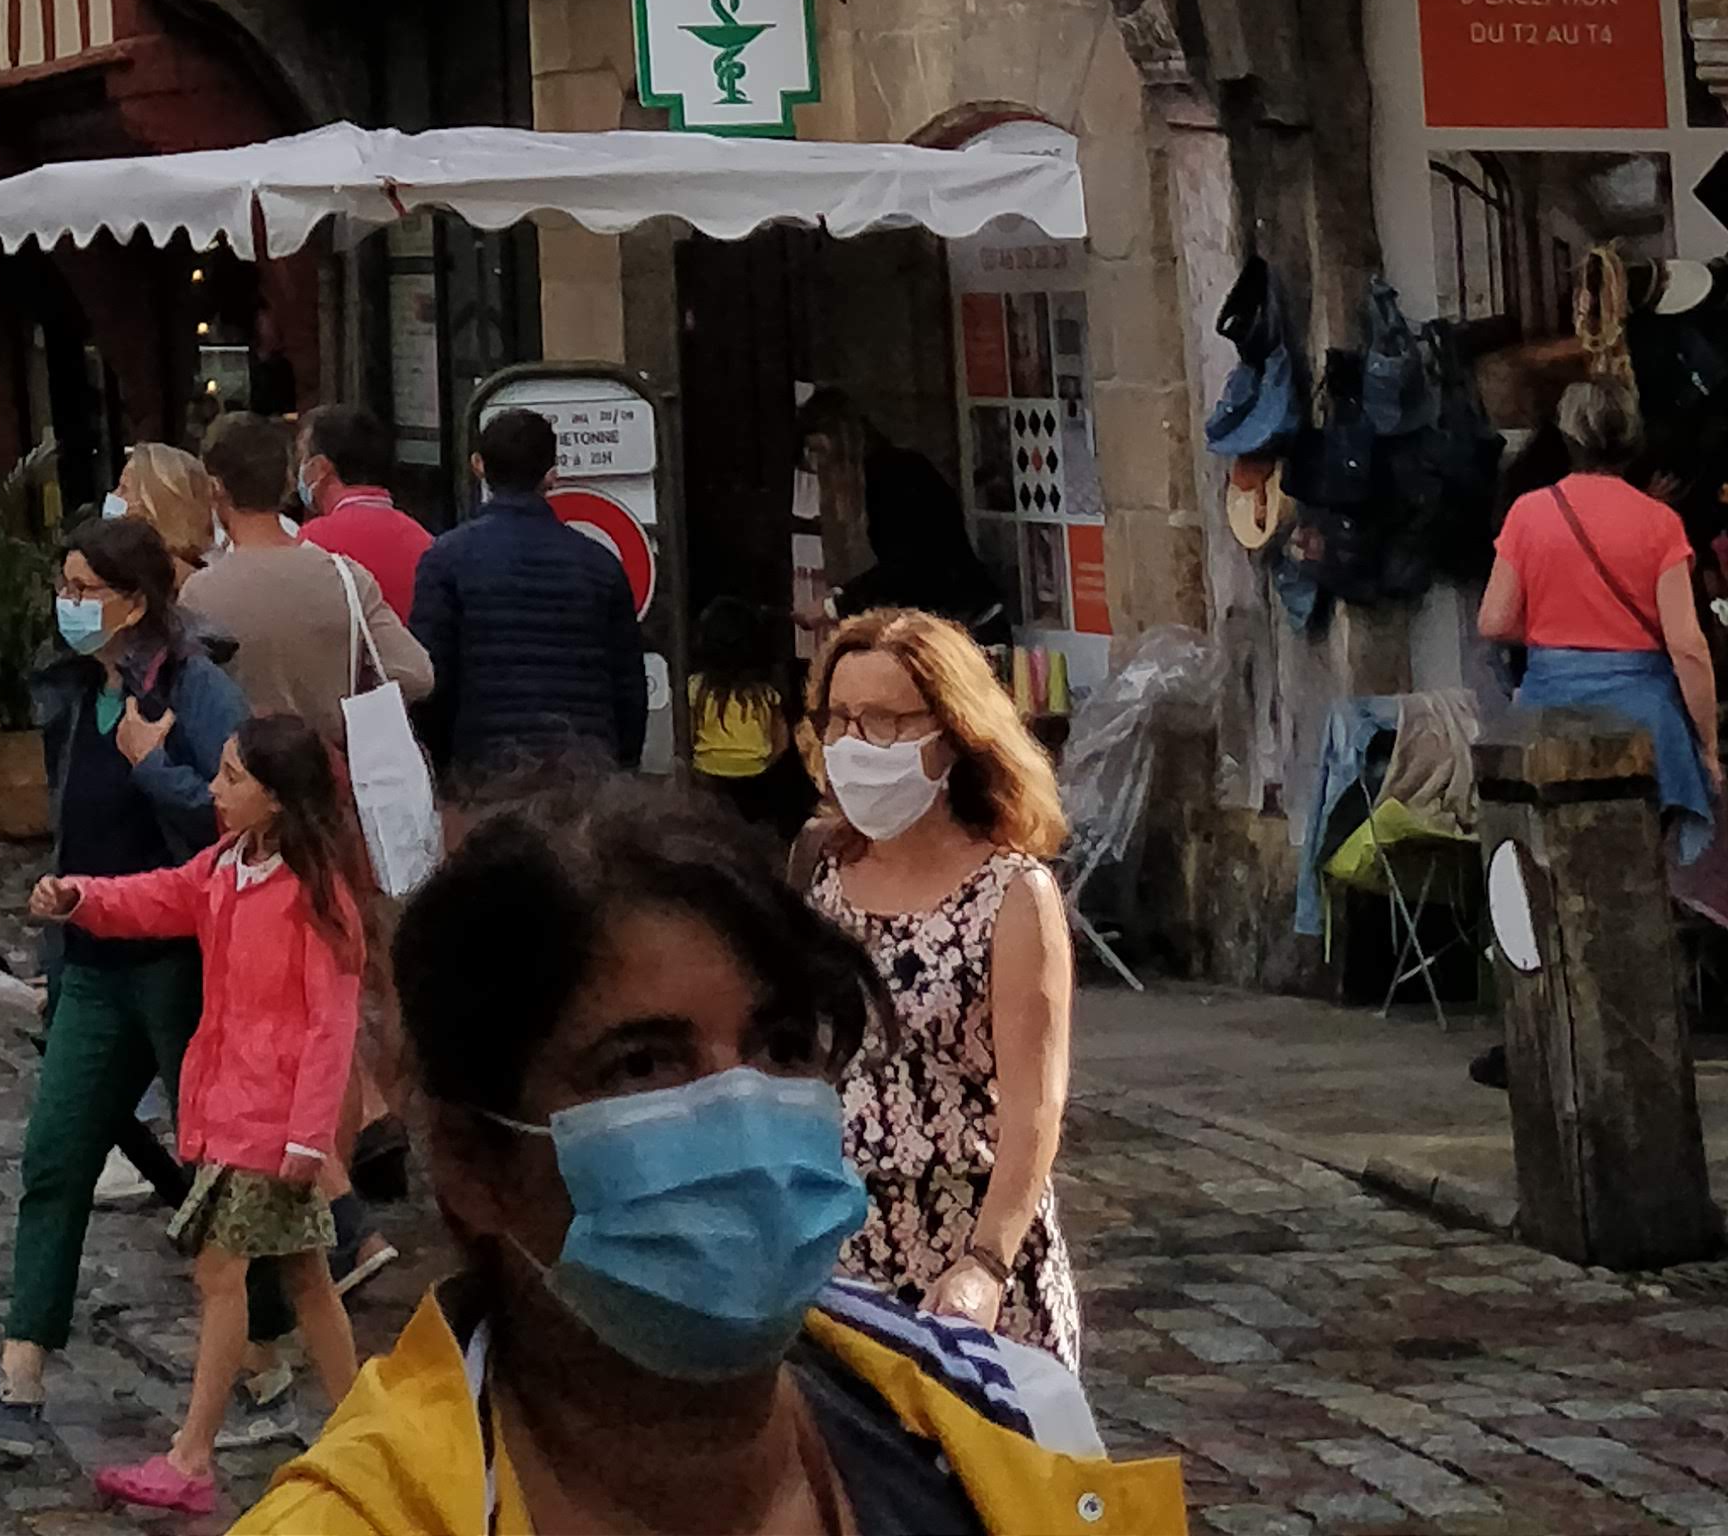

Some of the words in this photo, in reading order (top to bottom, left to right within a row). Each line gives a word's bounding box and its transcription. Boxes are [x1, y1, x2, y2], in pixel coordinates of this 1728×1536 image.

[1470, 22, 1505, 44] DU
[1511, 23, 1538, 45] T2
[1545, 24, 1579, 45] AU
